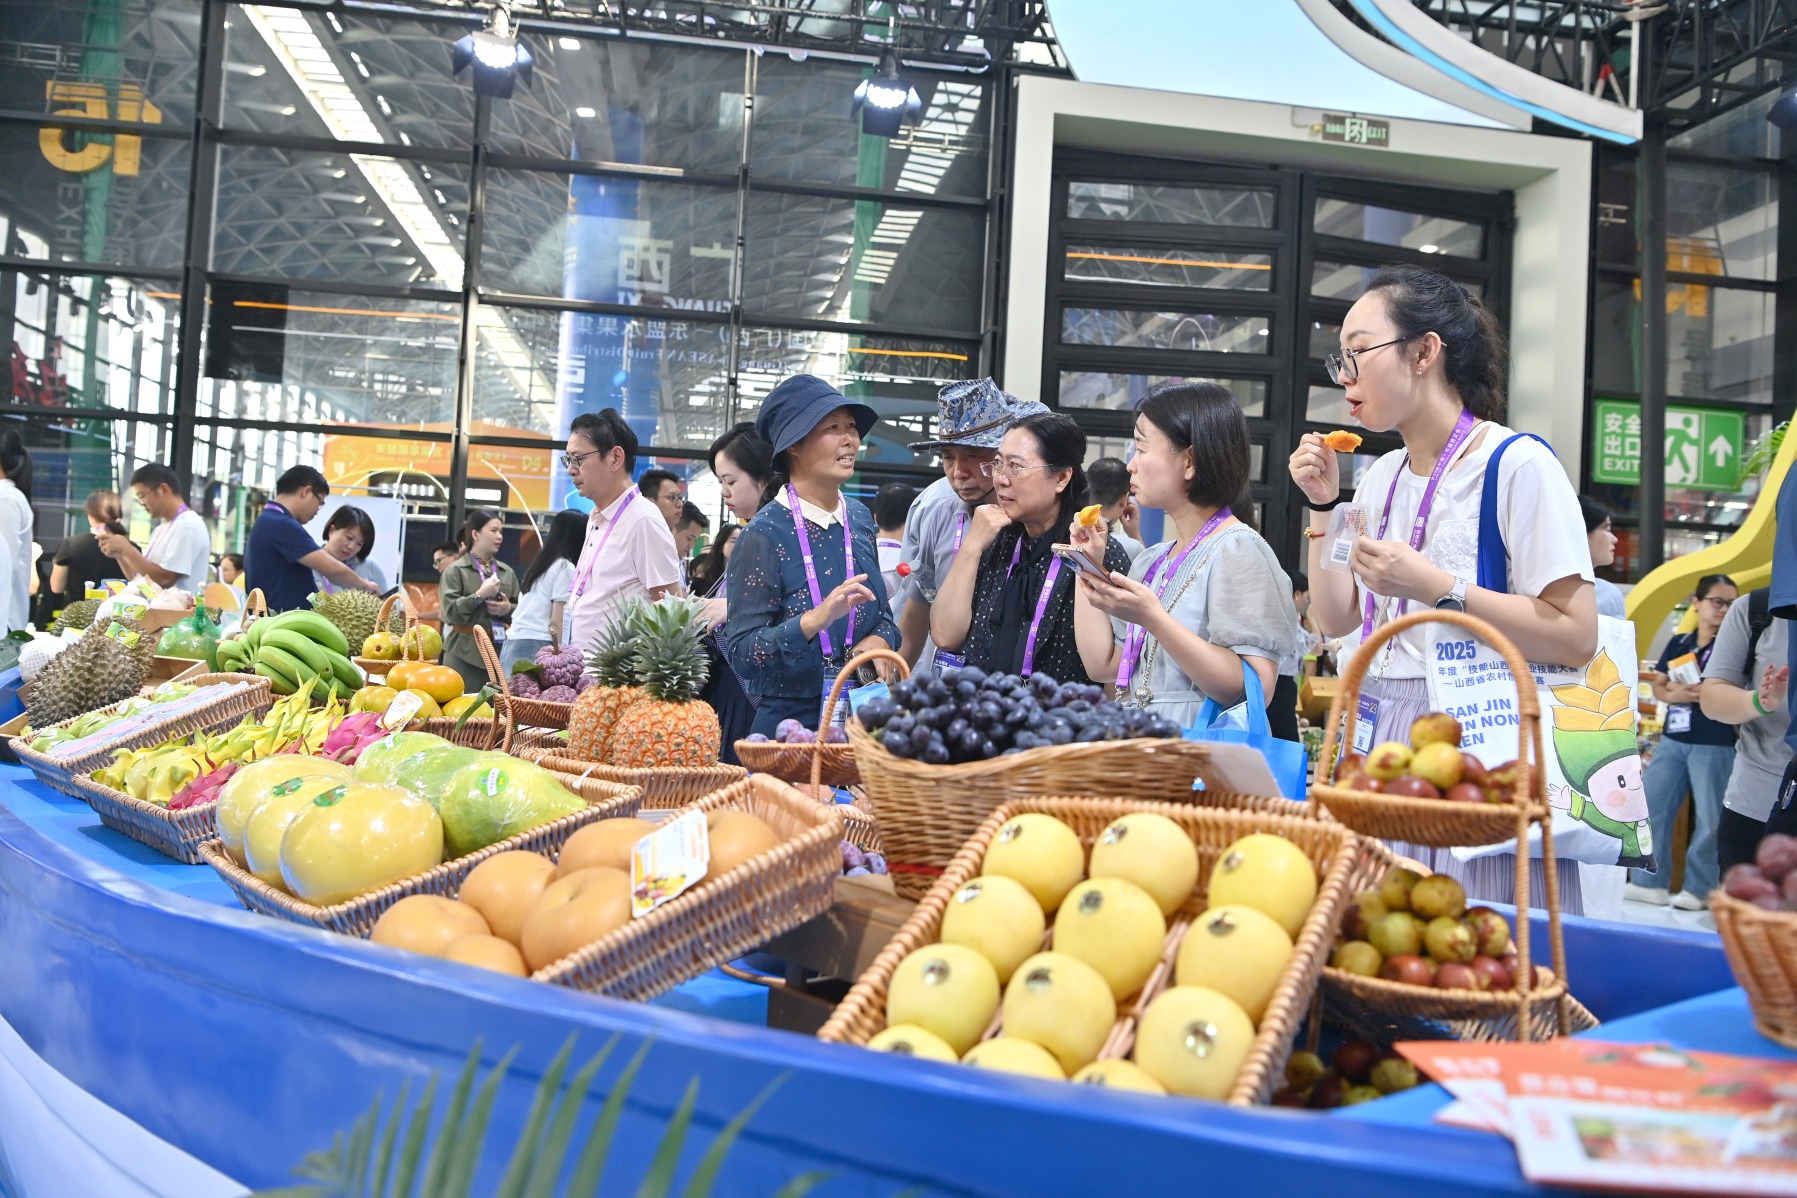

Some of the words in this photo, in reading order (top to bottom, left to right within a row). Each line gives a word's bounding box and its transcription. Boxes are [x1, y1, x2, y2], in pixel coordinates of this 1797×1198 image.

[1605, 412, 1641, 434] 安全
[1605, 434, 1641, 456] 出口
[1604, 458, 1641, 472] EXIT
[1436, 640, 1477, 661] 2025
[1445, 703, 1479, 718] SAN
[1483, 698, 1512, 712] JIN
[1458, 733, 1485, 749] EN
